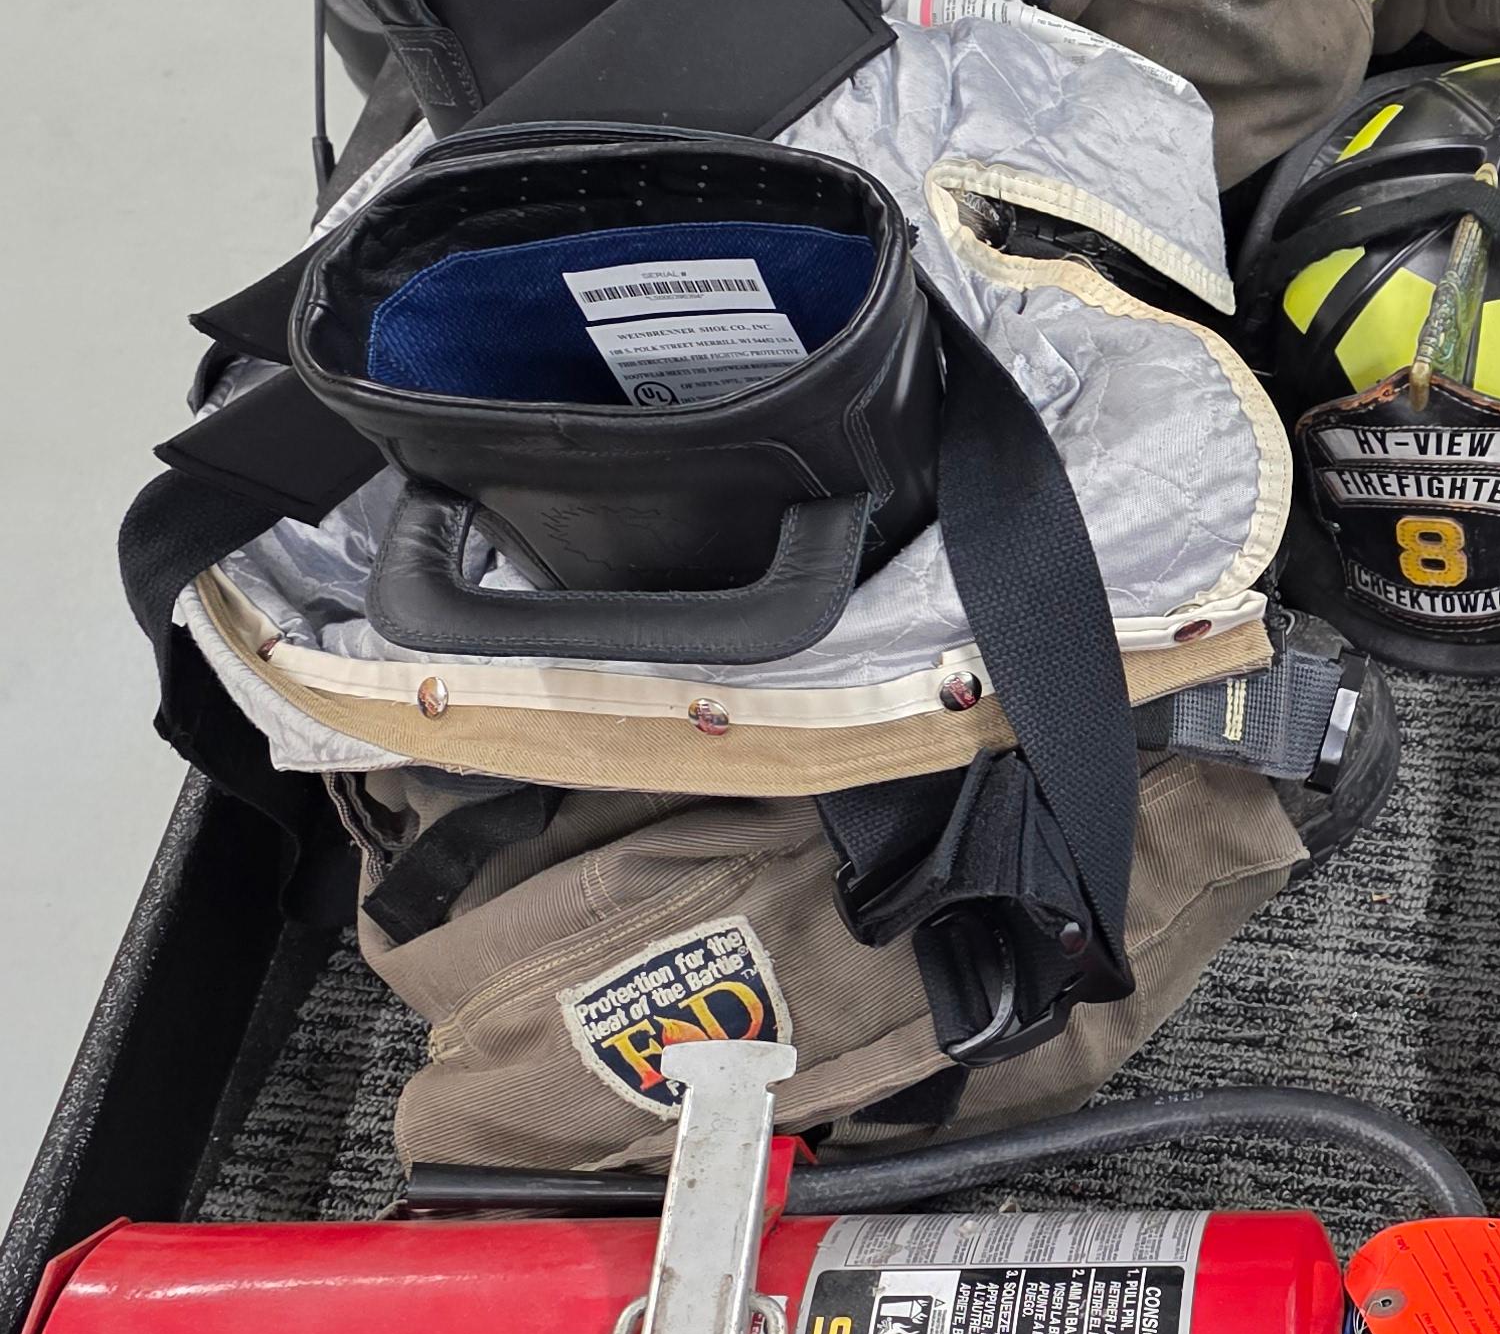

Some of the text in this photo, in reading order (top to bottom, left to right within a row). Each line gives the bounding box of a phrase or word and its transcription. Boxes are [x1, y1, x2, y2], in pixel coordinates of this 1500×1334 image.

[617, 327, 695, 340] WEINBRENNER
[700, 325, 728, 333] SHOE
[659, 342, 693, 351] STREET
[696, 339, 738, 347] MERRILL
[710, 351, 749, 360] FIGHTING
[642, 387, 668, 402] UL
[1357, 429, 1496, 458] HY-VIEW
[1395, 515, 1468, 588] 8
[575, 930, 743, 1023] Protection for the
[584, 1008, 629, 1042] Heat
[630, 996, 650, 1021] of
[651, 983, 686, 1008] the
[1005, 1270, 1018, 1279] 3.
[1072, 1269, 1085, 1278] 2.
[1022, 1282, 1037, 1317] FUEGO.
[1034, 1282, 1050, 1321] APUNTE
[1051, 1282, 1066, 1310] VISER
[1068, 1281, 1083, 1300] AIM
[1092, 1281, 1106, 1316] RETIRE
[1105, 1281, 1121, 1322] RETIRER
[1120, 1268, 1140, 1331] 1. PULL PIN.
[952, 1282, 972, 1326] APRIETE,
[1067, 1301, 1080, 1316] AT
[1033, 1321, 1044, 1330] A
[1049, 1311, 1061, 1325] LA
[1089, 1317, 1100, 1331] EL
